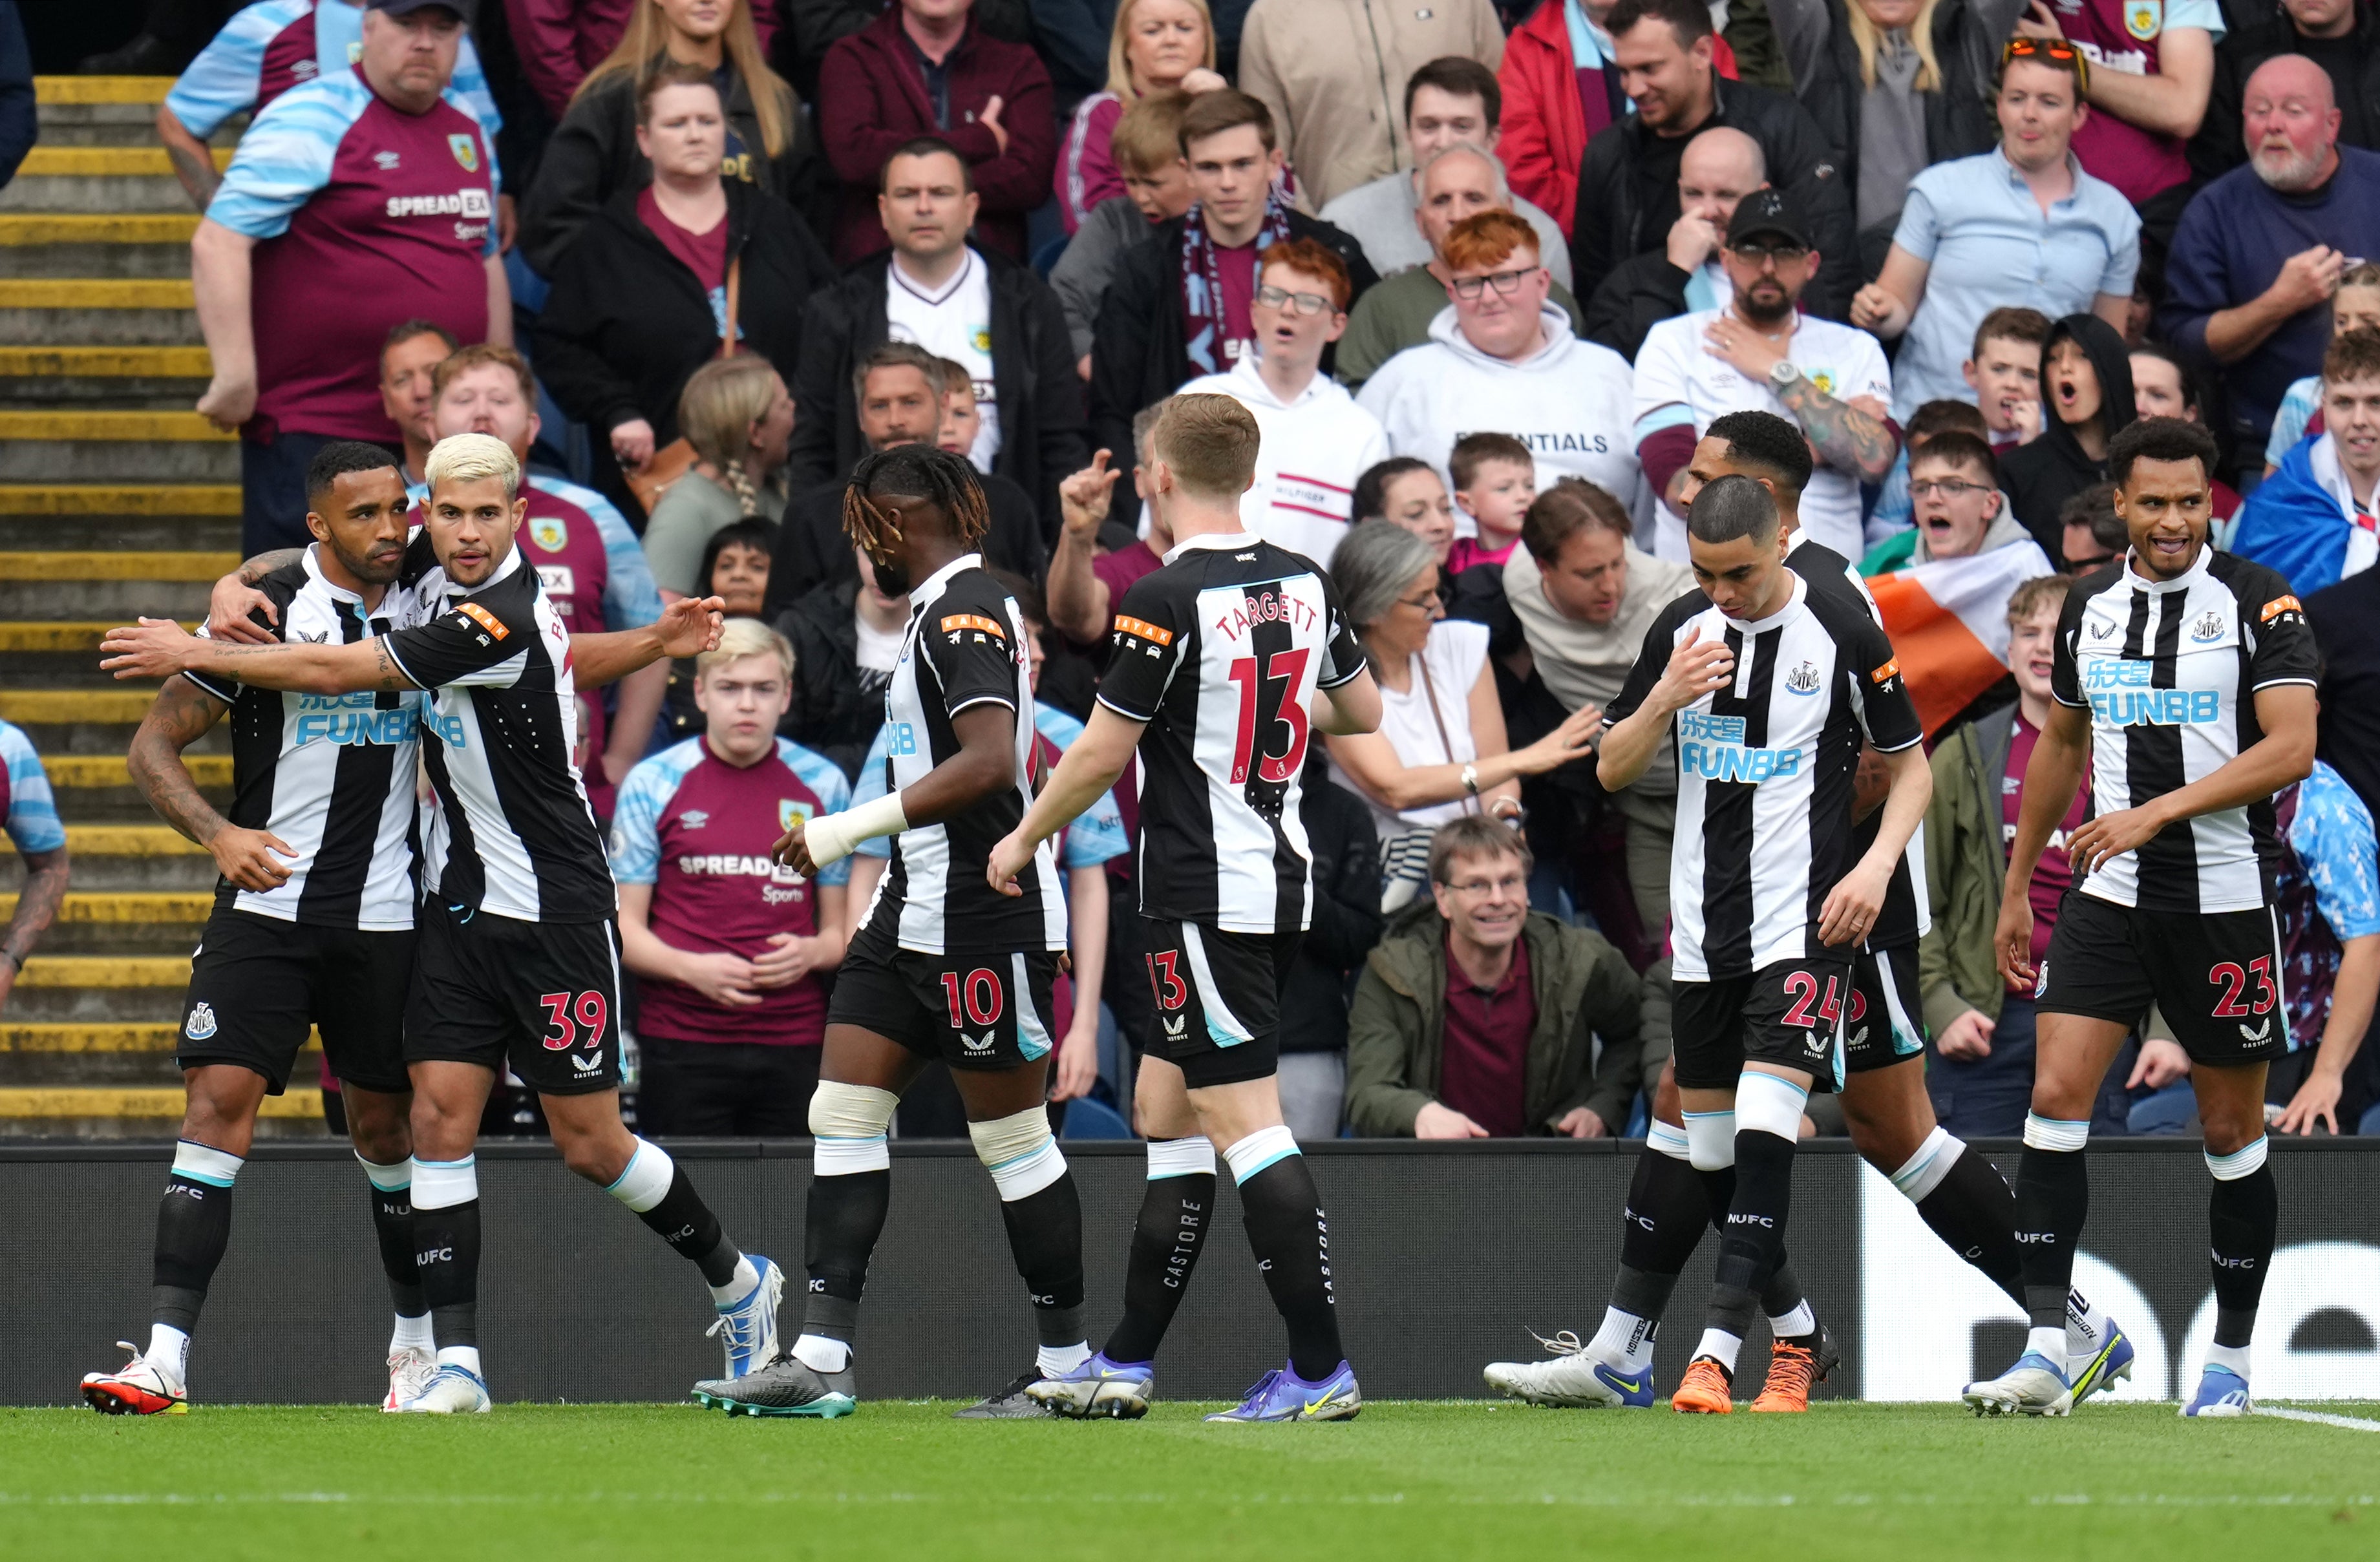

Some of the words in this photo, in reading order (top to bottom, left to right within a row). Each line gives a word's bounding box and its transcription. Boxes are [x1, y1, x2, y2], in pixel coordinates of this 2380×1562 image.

[461, 604, 505, 637] AYAK
[1216, 591, 1317, 641] TARGETT
[2261, 597, 2300, 617] KAYA
[944, 617, 1004, 635] KAYA
[2085, 659, 2152, 688] 乐天堂
[1227, 648, 1310, 785] 13
[2090, 690, 2220, 725] FUN88
[1681, 710, 1745, 744] 乐天堂
[1682, 742, 1802, 781] FUN88
[761, 884, 803, 906] Sports
[1145, 949, 1187, 1010] 13
[2209, 953, 2277, 1017] 23
[940, 967, 1003, 1028] 10
[1780, 970, 1841, 1033] 24
[540, 989, 607, 1051] 39
[2242, 1037, 2273, 1049] CASTORE
[573, 1069, 603, 1079] CASTORE
[383, 1202, 410, 1216] NU
[1727, 1213, 1774, 1229] NUFC
[664, 1223, 695, 1243] UFC
[1163, 1199, 1200, 1288] CASTORE
[1317, 1207, 1335, 1305] CASTORE
[809, 1279, 825, 1293] FC
